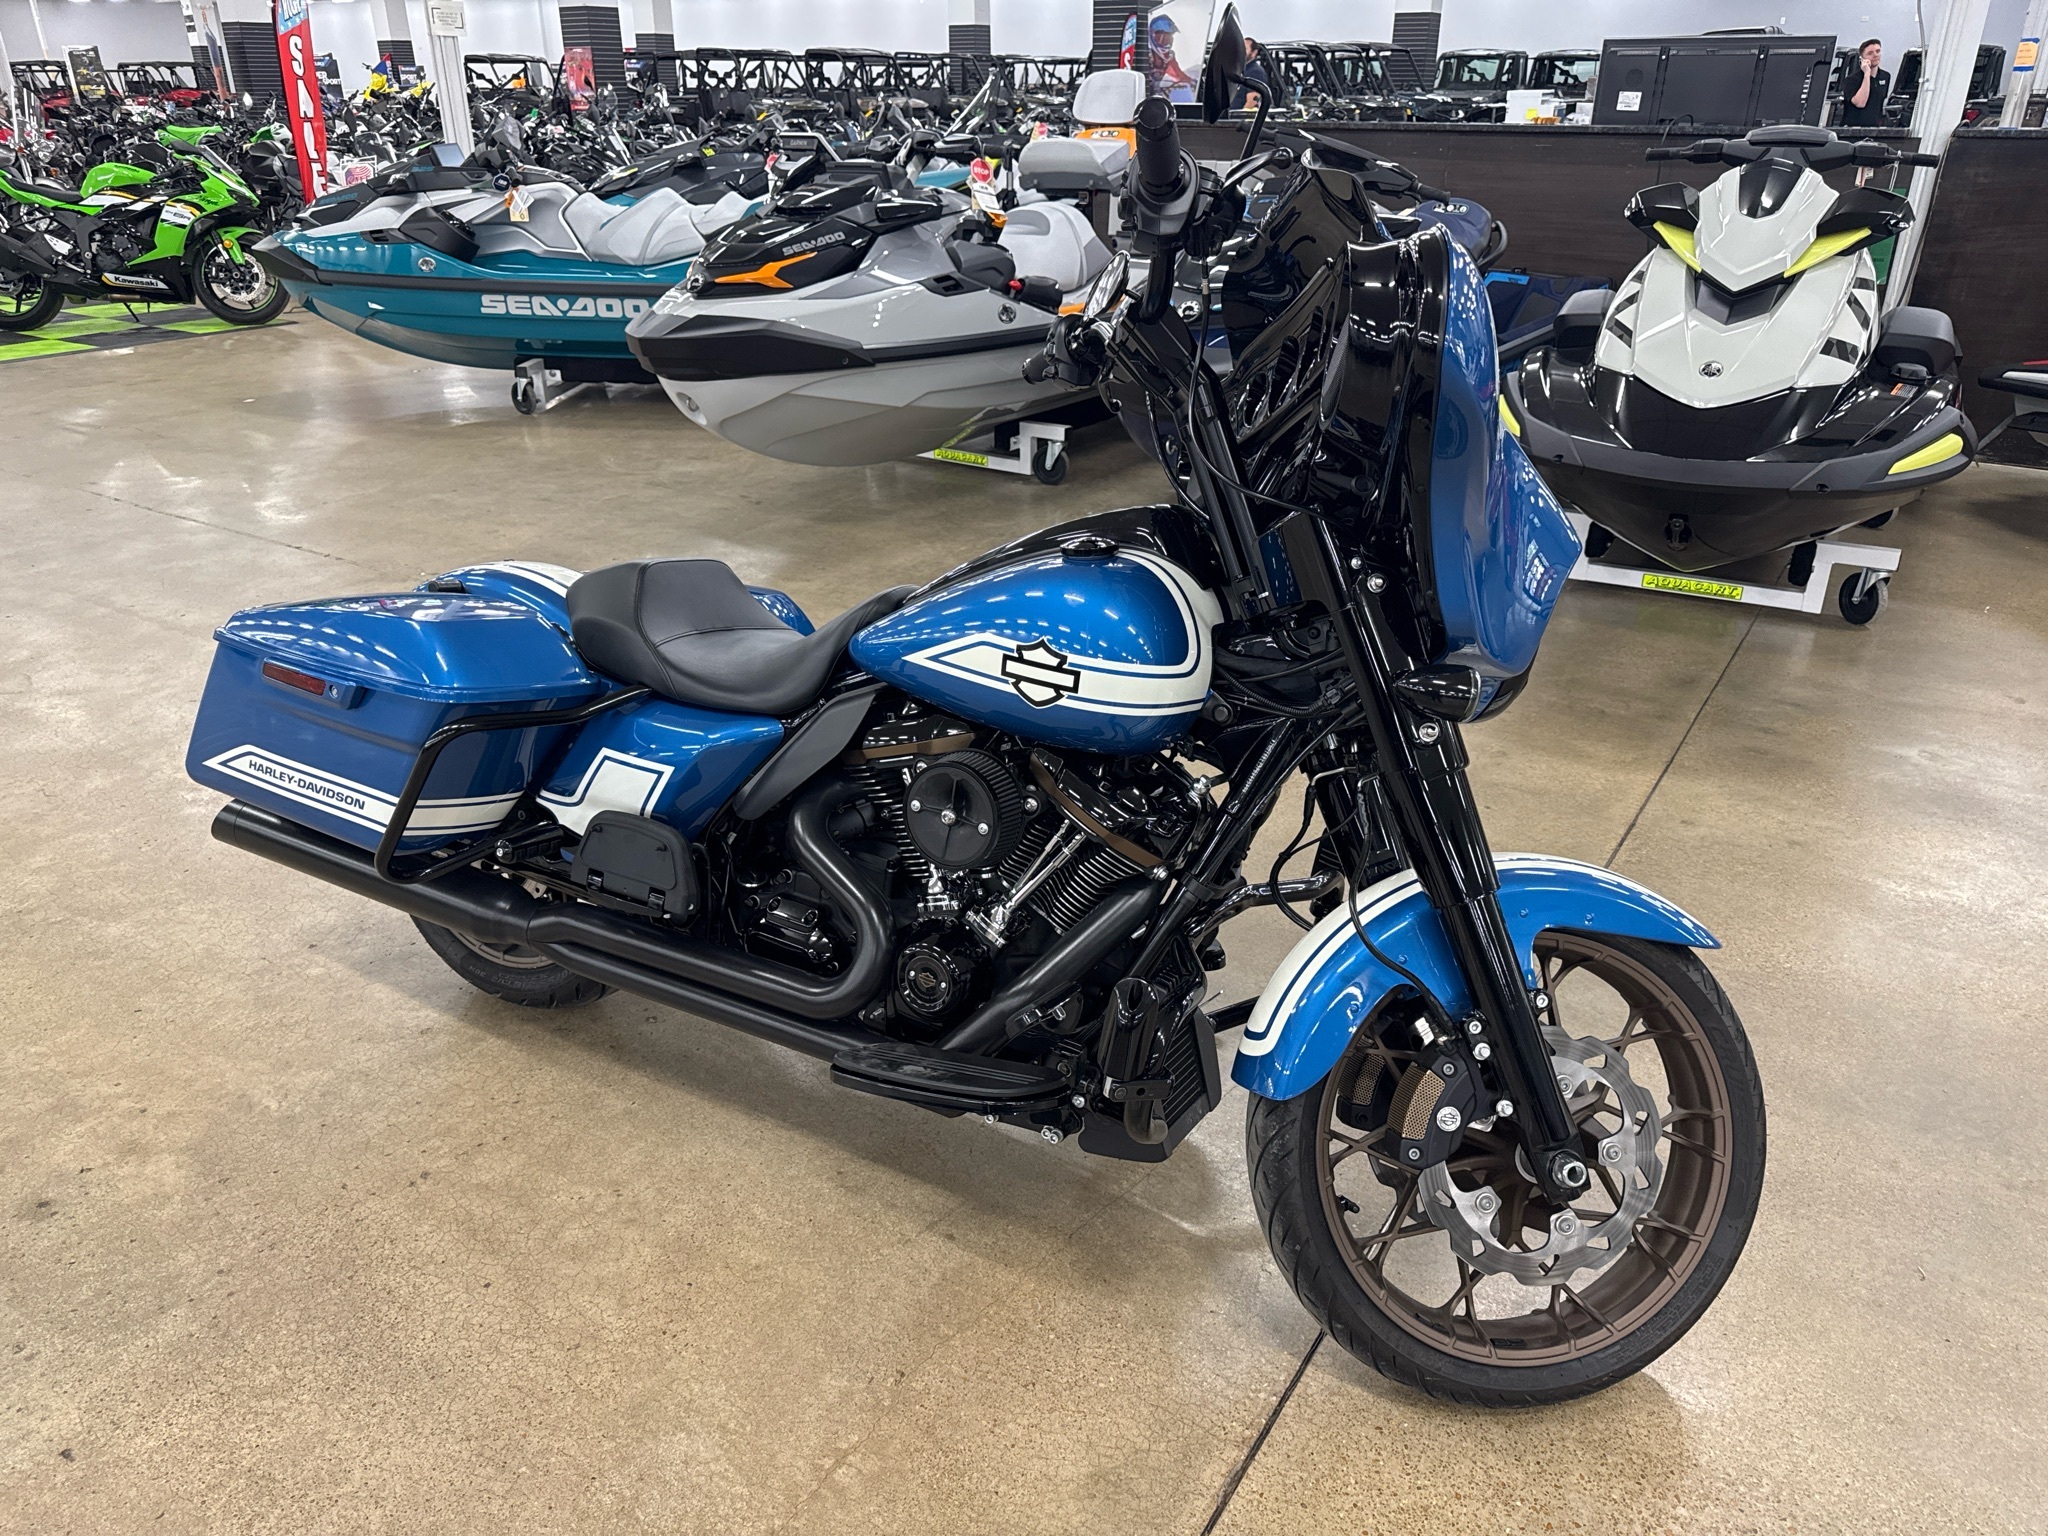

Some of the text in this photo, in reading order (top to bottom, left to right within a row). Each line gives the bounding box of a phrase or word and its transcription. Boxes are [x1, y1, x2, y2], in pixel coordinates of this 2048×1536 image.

[289, 34, 327, 198] SALE
[973, 167, 989, 176] STOP
[114, 276, 158, 287] Kawasaki
[249, 760, 365, 810] HARLEY-DAVIDSON
